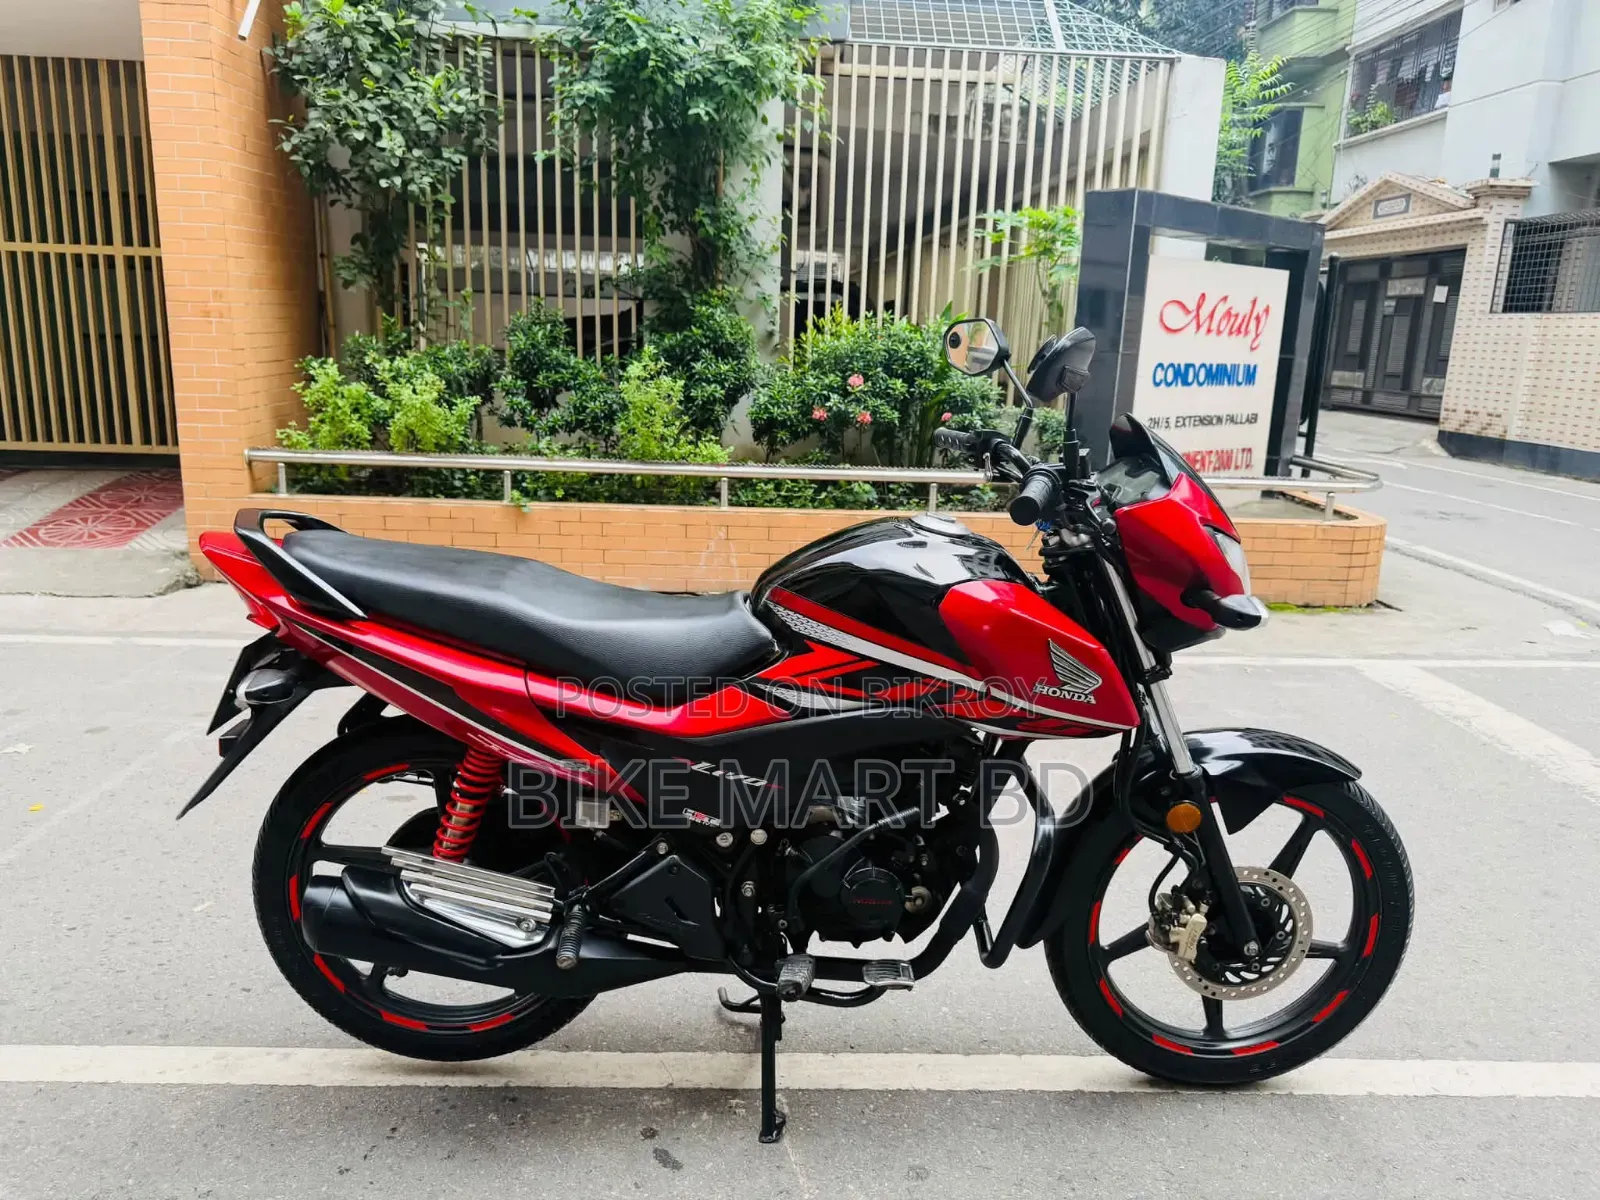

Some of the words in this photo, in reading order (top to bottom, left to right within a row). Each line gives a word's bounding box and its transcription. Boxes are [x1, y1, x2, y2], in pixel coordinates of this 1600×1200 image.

[1159, 292, 1270, 352] Mouly
[1152, 362, 1258, 387] CONDOMINIUM
[1174, 414, 1223, 428] EXTENSION
[1033, 683, 1097, 705] HONDA
